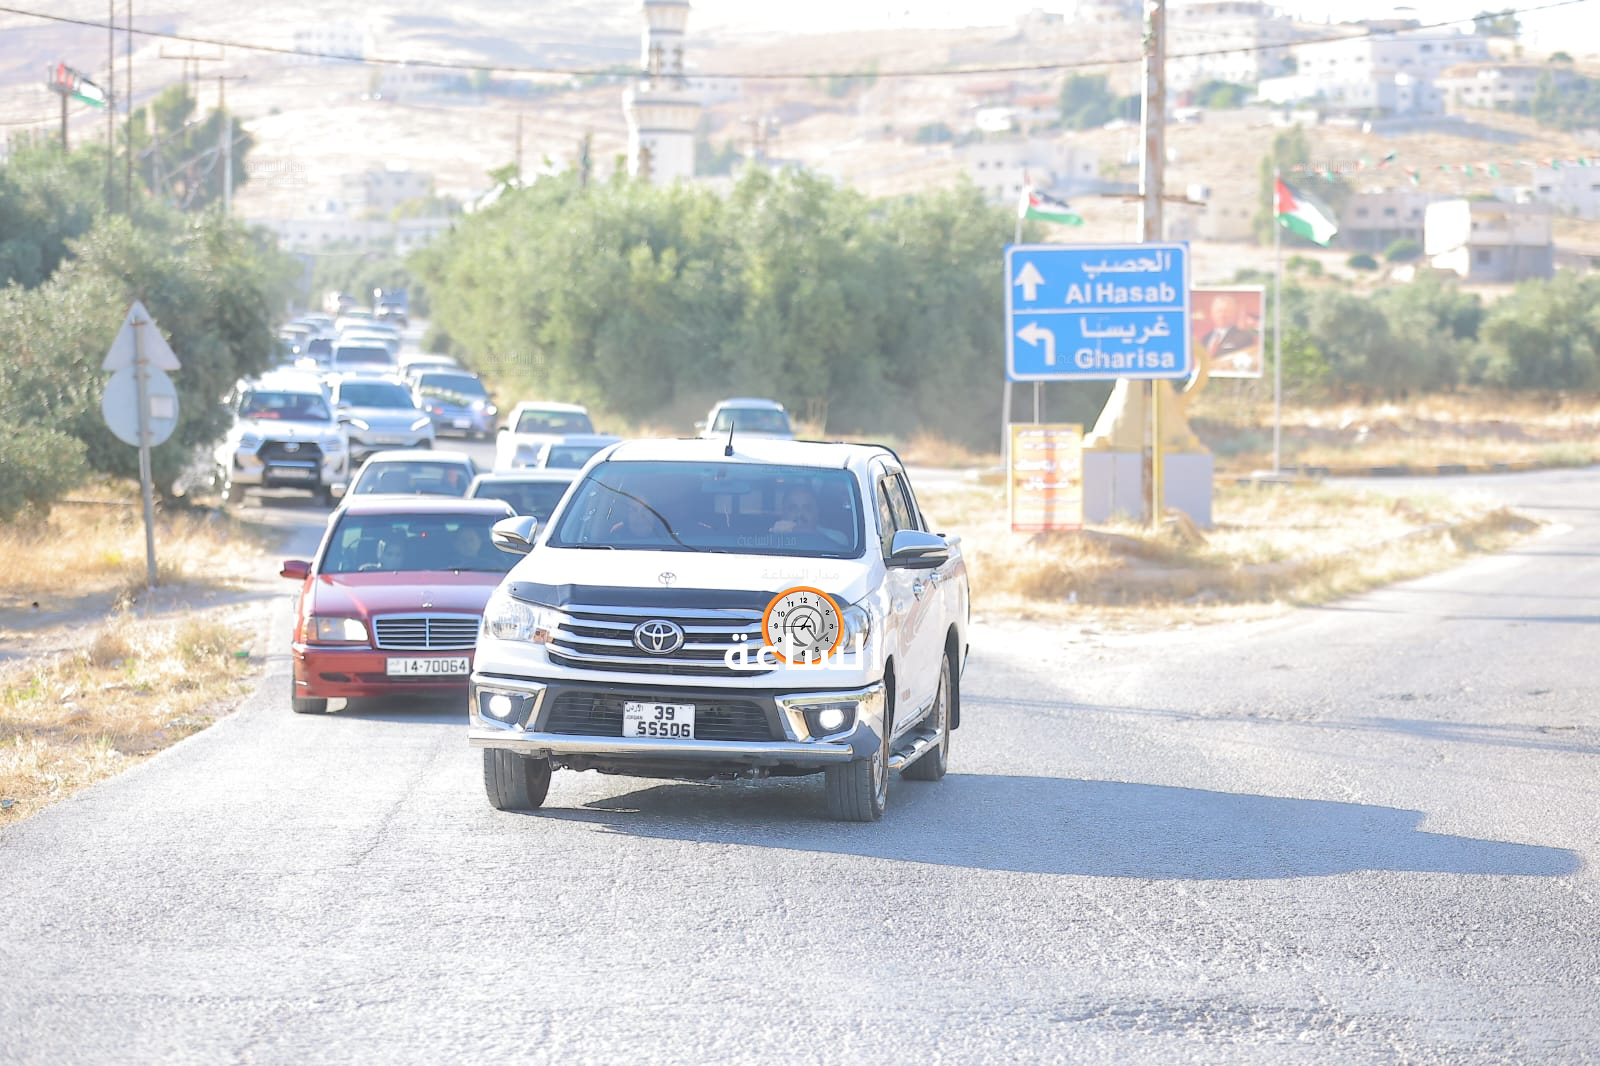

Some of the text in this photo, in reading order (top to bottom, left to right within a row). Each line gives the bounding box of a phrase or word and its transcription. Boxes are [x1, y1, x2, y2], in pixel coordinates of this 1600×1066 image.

[1065, 282, 1176, 304] Al Hasab
[1080, 315, 1170, 344] غريسا
[1074, 347, 1175, 369] Gharisa
[404, 660, 466, 673] 14-70064
[654, 705, 675, 720] 39
[637, 720, 691, 737] 55506
